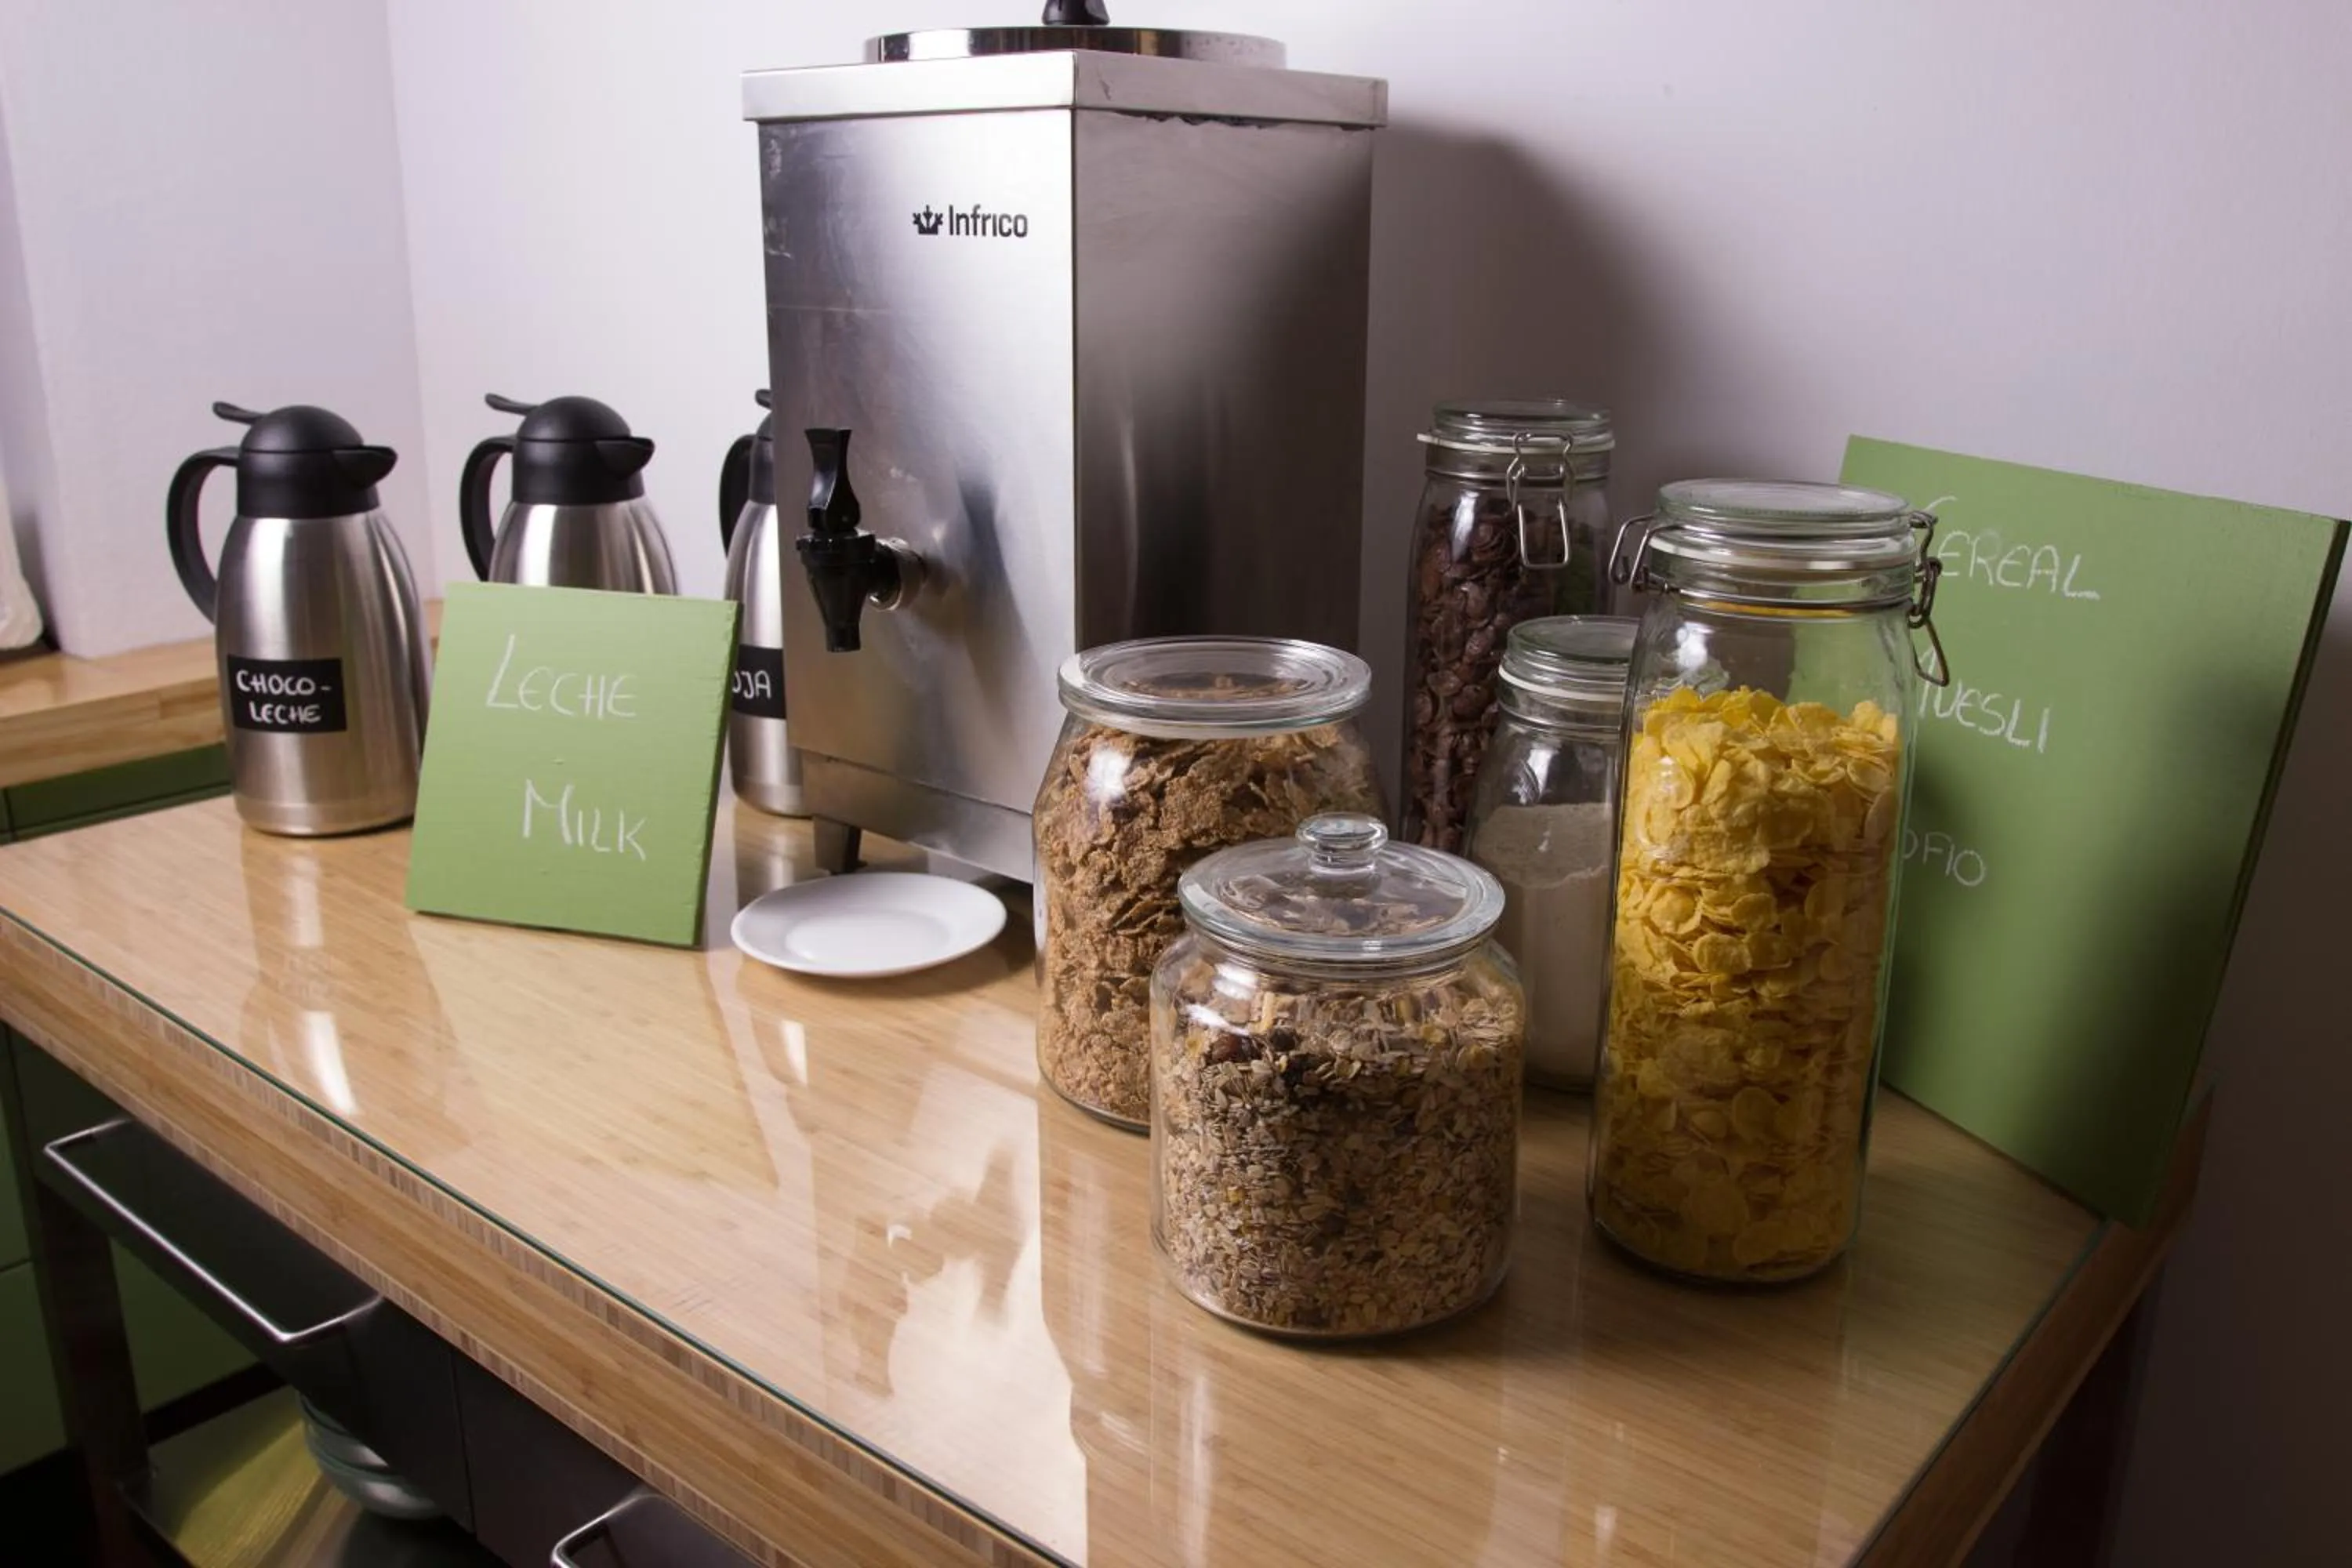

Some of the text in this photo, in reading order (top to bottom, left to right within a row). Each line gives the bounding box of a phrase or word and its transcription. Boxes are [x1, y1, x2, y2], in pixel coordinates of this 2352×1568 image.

[949, 204, 1029, 238] Infrico
[486, 633, 637, 720] LECHE
[249, 701, 321, 724] LECHE
[523, 778, 648, 862] MILK
